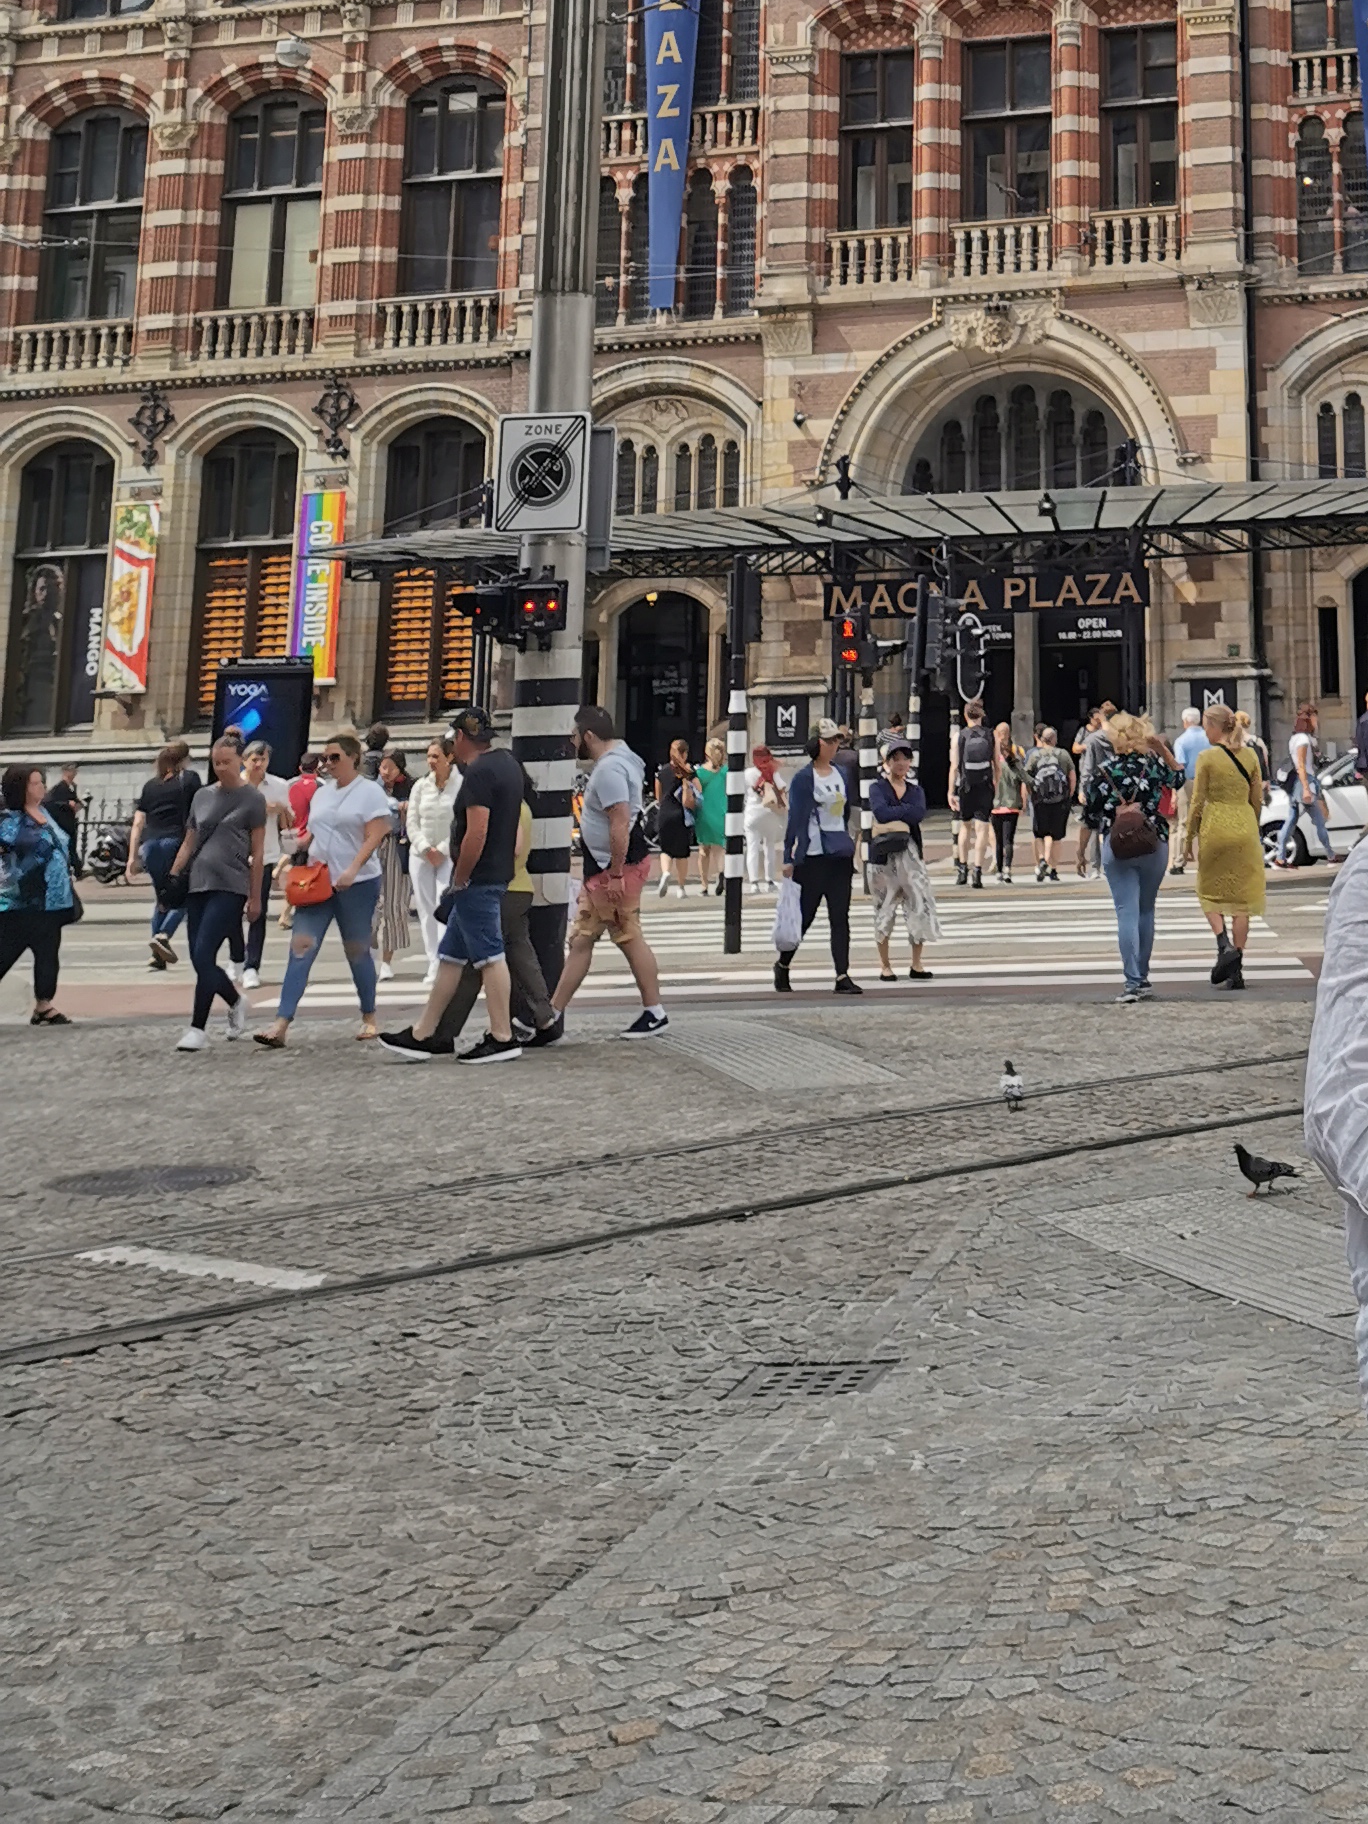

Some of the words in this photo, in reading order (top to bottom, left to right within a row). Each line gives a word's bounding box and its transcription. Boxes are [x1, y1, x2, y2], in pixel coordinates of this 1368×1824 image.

[524, 423, 562, 436] ZONE
[307, 520, 333, 576] COE
[301, 582, 328, 648] INSIDE
[829, 578, 989, 617] MAGA
[1003, 571, 1144, 609] PLAZA
[85, 607, 103, 676] MANGO
[1077, 617, 1107, 629] OPEN
[228, 683, 269, 697] YOGA
